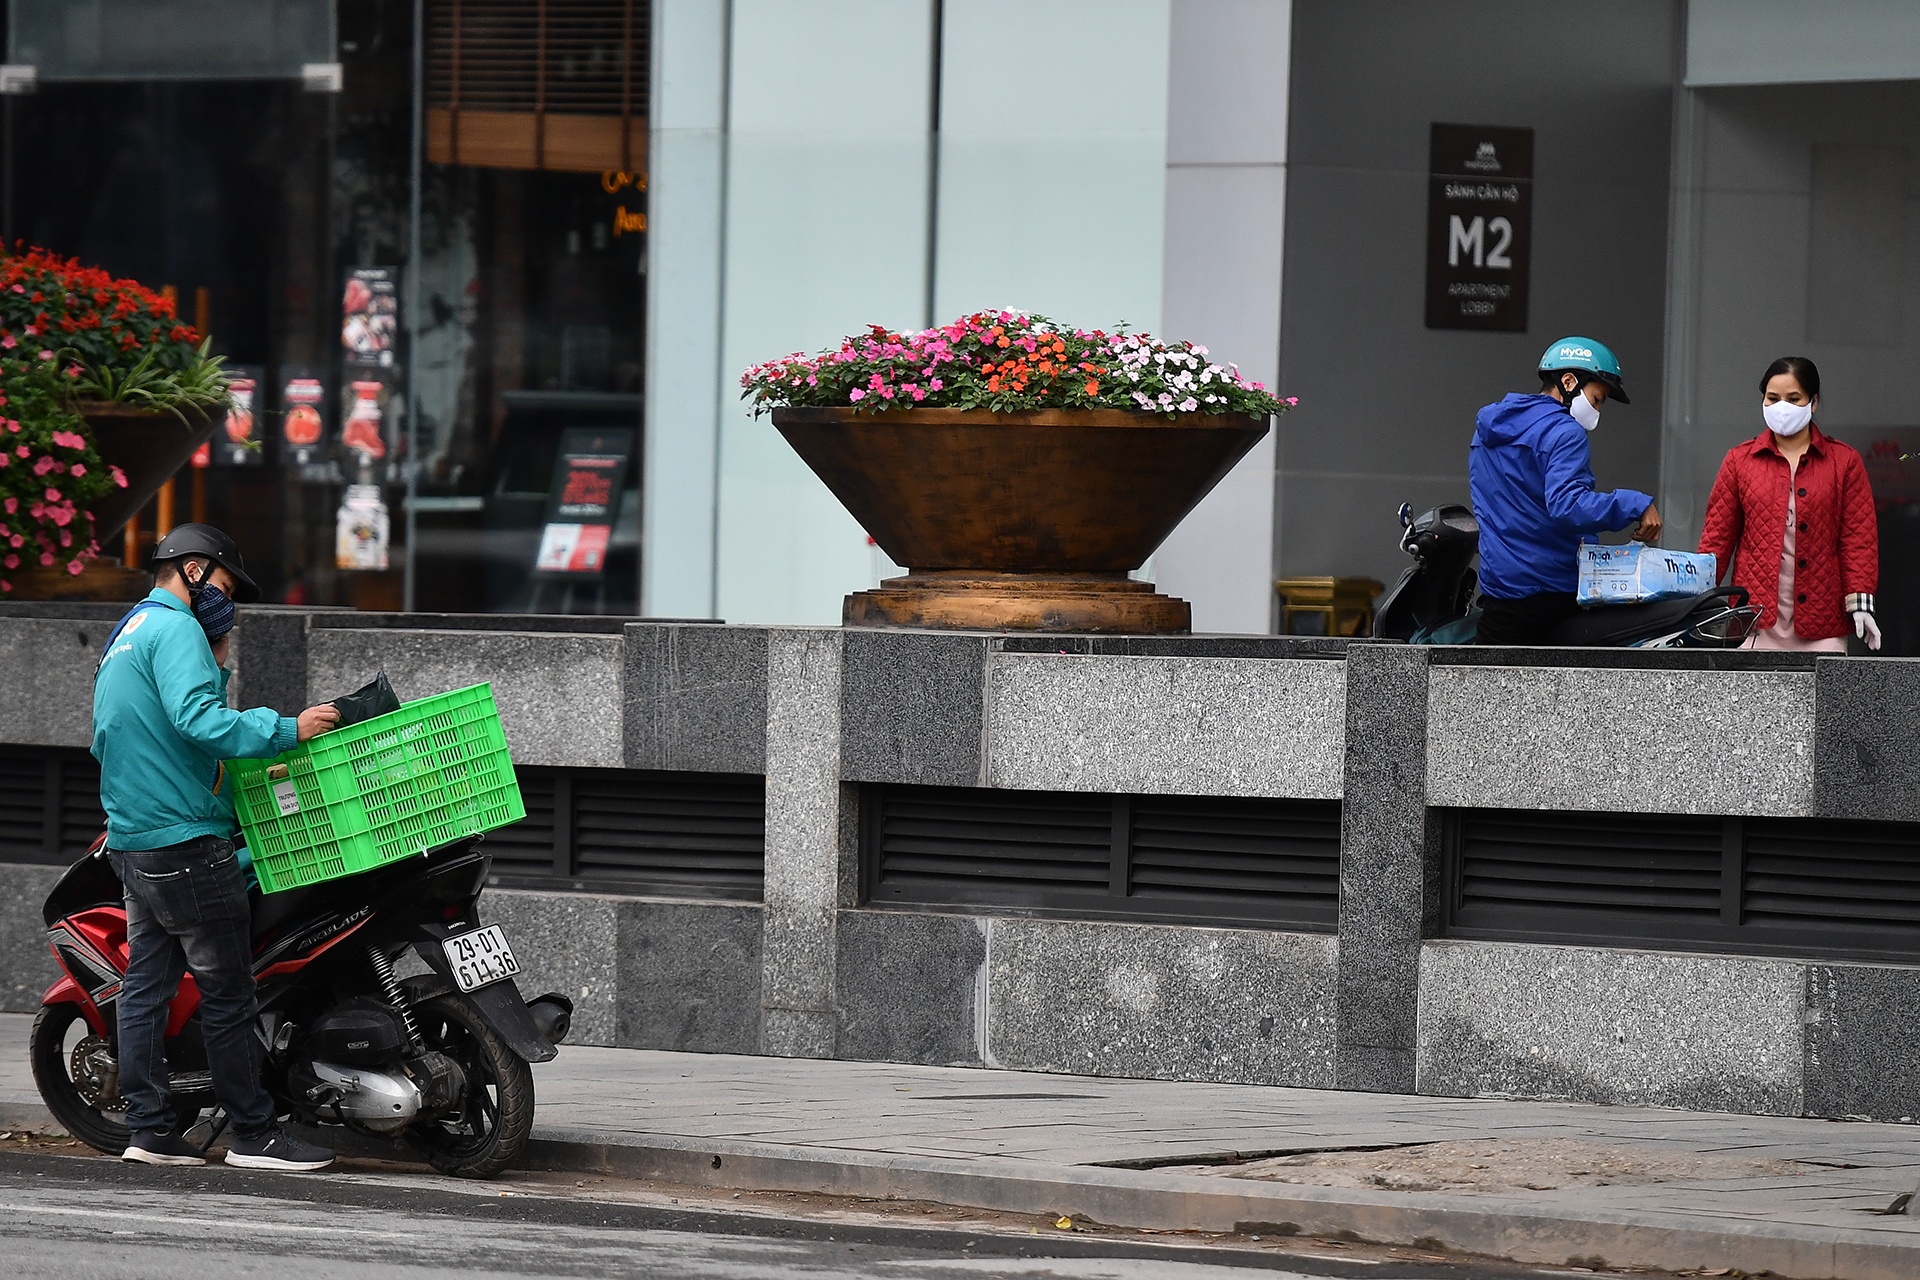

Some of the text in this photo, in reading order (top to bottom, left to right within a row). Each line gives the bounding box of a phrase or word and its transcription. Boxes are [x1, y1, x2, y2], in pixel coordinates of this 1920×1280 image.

[1448, 215, 1512, 268] M2
[1448, 283, 1510, 298] APARTMENT
[1461, 301, 1496, 314] LOBBY
[447, 921, 466, 930] HONDA
[453, 929, 500, 962] 29-D1
[459, 951, 516, 987] 611.36
